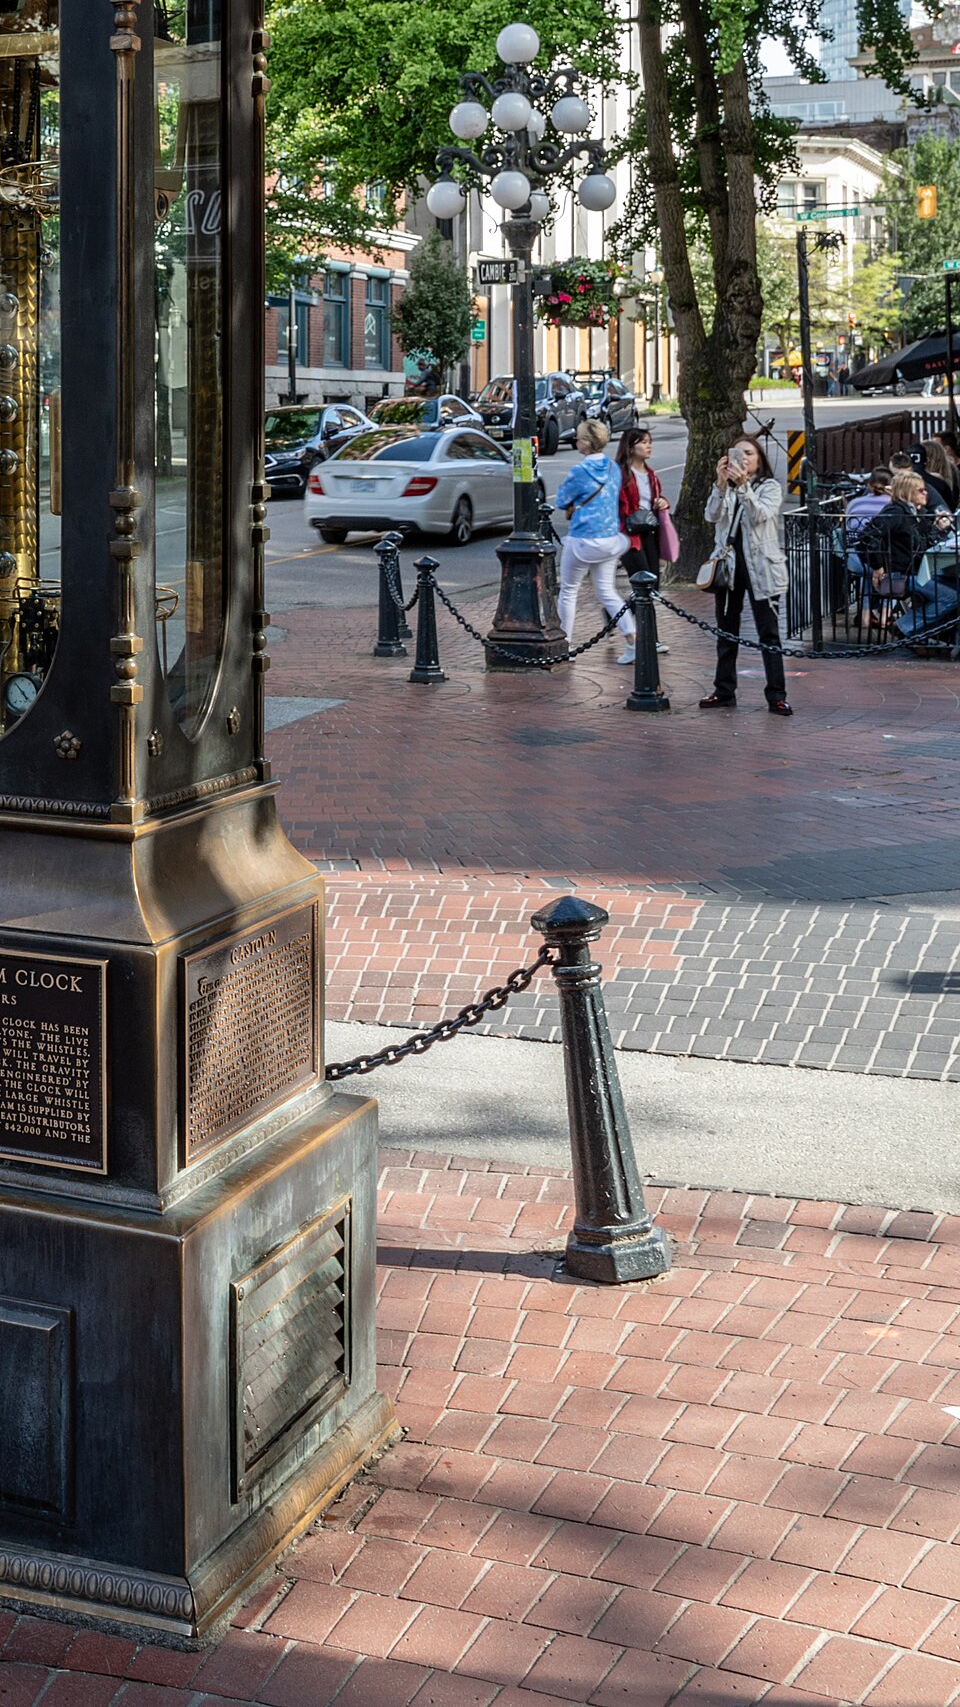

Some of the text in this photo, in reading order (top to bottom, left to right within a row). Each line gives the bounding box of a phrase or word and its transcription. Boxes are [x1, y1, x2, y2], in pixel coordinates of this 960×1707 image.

[810, 210, 843, 220] Cordova
[481, 264, 506, 281] CAMBIE
[230, 929, 277, 965] GASTOWN
[15, 969, 83, 993] CLOCK
[2, 1017, 37, 1029] CLOCK
[41, 1021, 60, 1032] HAS
[63, 1024, 89, 1036] BEEN
[11, 1038, 32, 1049] THE
[36, 1042, 91, 1058] WHISTLES.
[40, 1032, 61, 1043] THE
[65, 1036, 89, 1047] LIVE
[2, 1048, 29, 1060] WILL
[32, 1052, 72, 1066] TRAVEL
[75, 1058, 89, 1068] BY
[16, 1060, 37, 1071] THE
[42, 1064, 90, 1079] GRAVITY
[3, 1079, 23, 1090] THE
[26, 1082, 62, 1096] CLOCK
[64, 1087, 90, 1100] WILL
[75, 1079, 89, 1089] BY
[5, 1090, 39, 1103] LARGE
[44, 1095, 90, 1111] WHISTLE
[17, 1103, 26, 1112] IS
[28, 1104, 73, 1119] SUPPLIED
[77, 1112, 90, 1122] BY
[19, 1112, 91, 1133] DISTRIBUTORS
[45, 1128, 67, 1140] AND
[71, 1132, 91, 1144] THE
